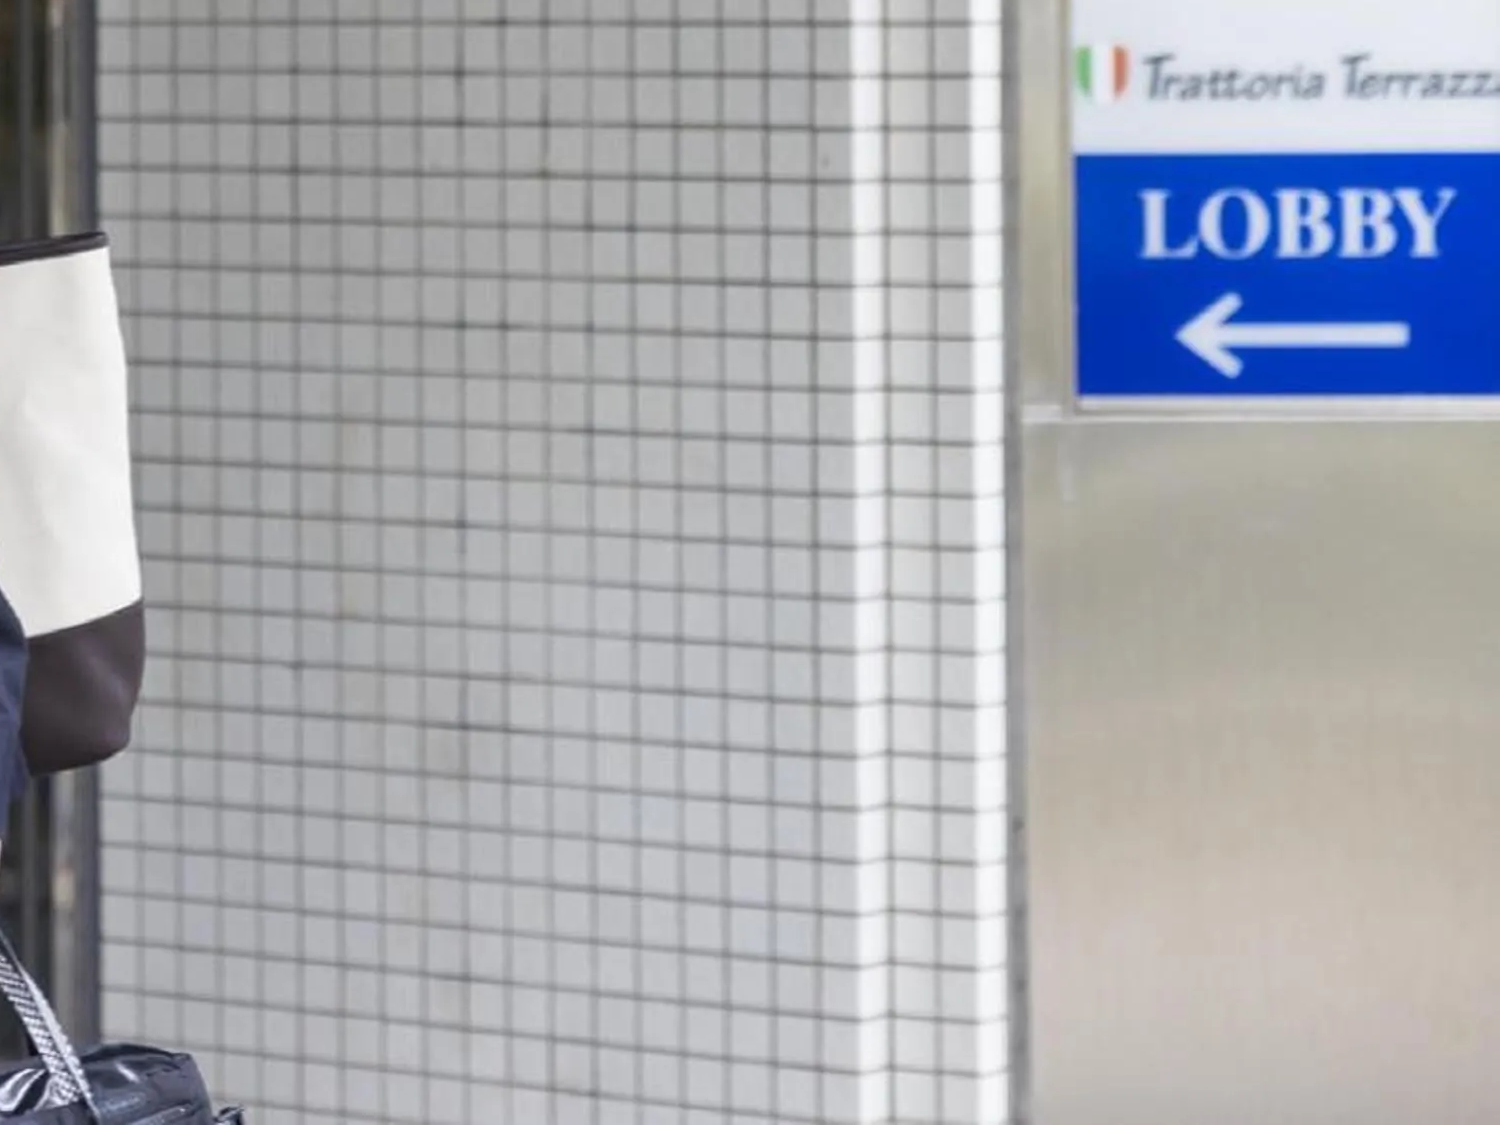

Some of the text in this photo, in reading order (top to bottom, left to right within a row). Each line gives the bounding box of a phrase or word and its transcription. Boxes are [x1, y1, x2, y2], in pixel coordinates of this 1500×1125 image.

[1142, 51, 1500, 101] Trattoria Terrazz
[1137, 187, 1458, 260] LOBBY
